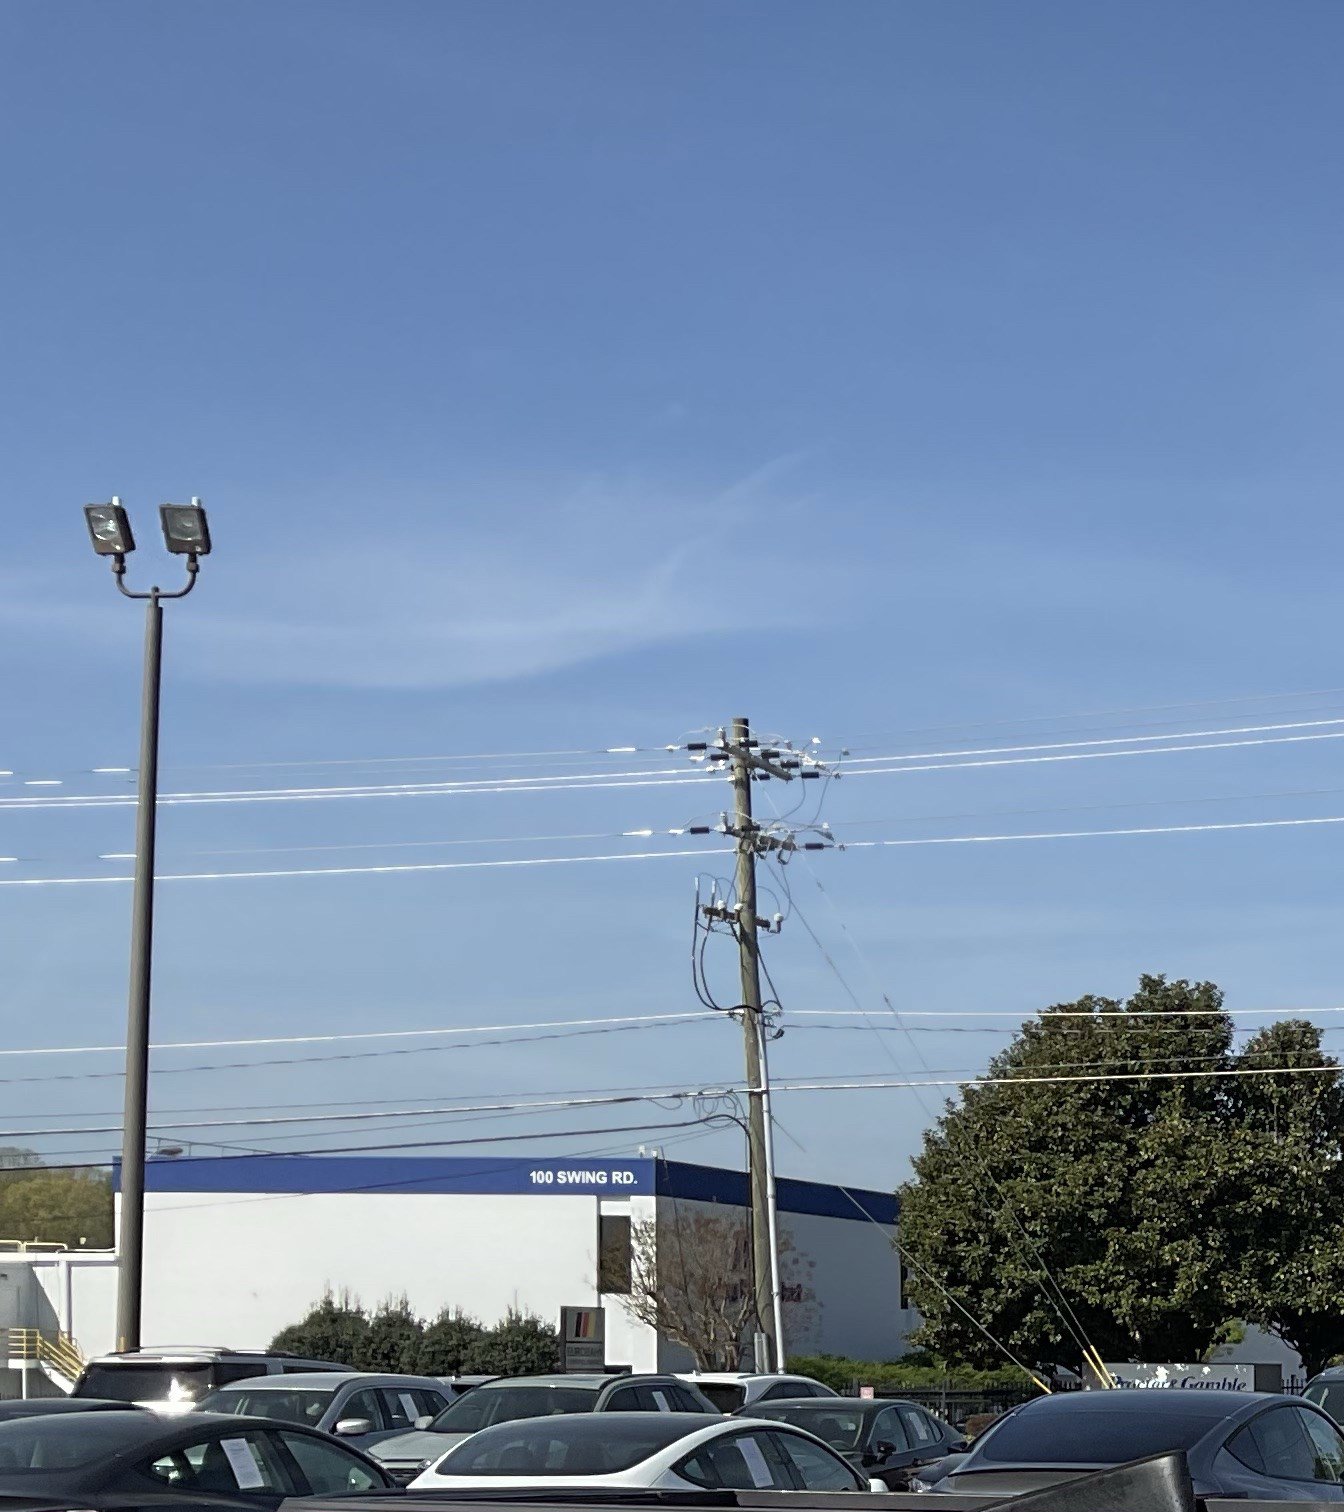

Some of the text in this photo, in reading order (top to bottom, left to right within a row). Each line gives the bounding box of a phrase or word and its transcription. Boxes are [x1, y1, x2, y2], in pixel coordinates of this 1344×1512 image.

[529, 1170, 638, 1185] 100 SWING RD.
[1181, 1376, 1248, 1391] Gamble
